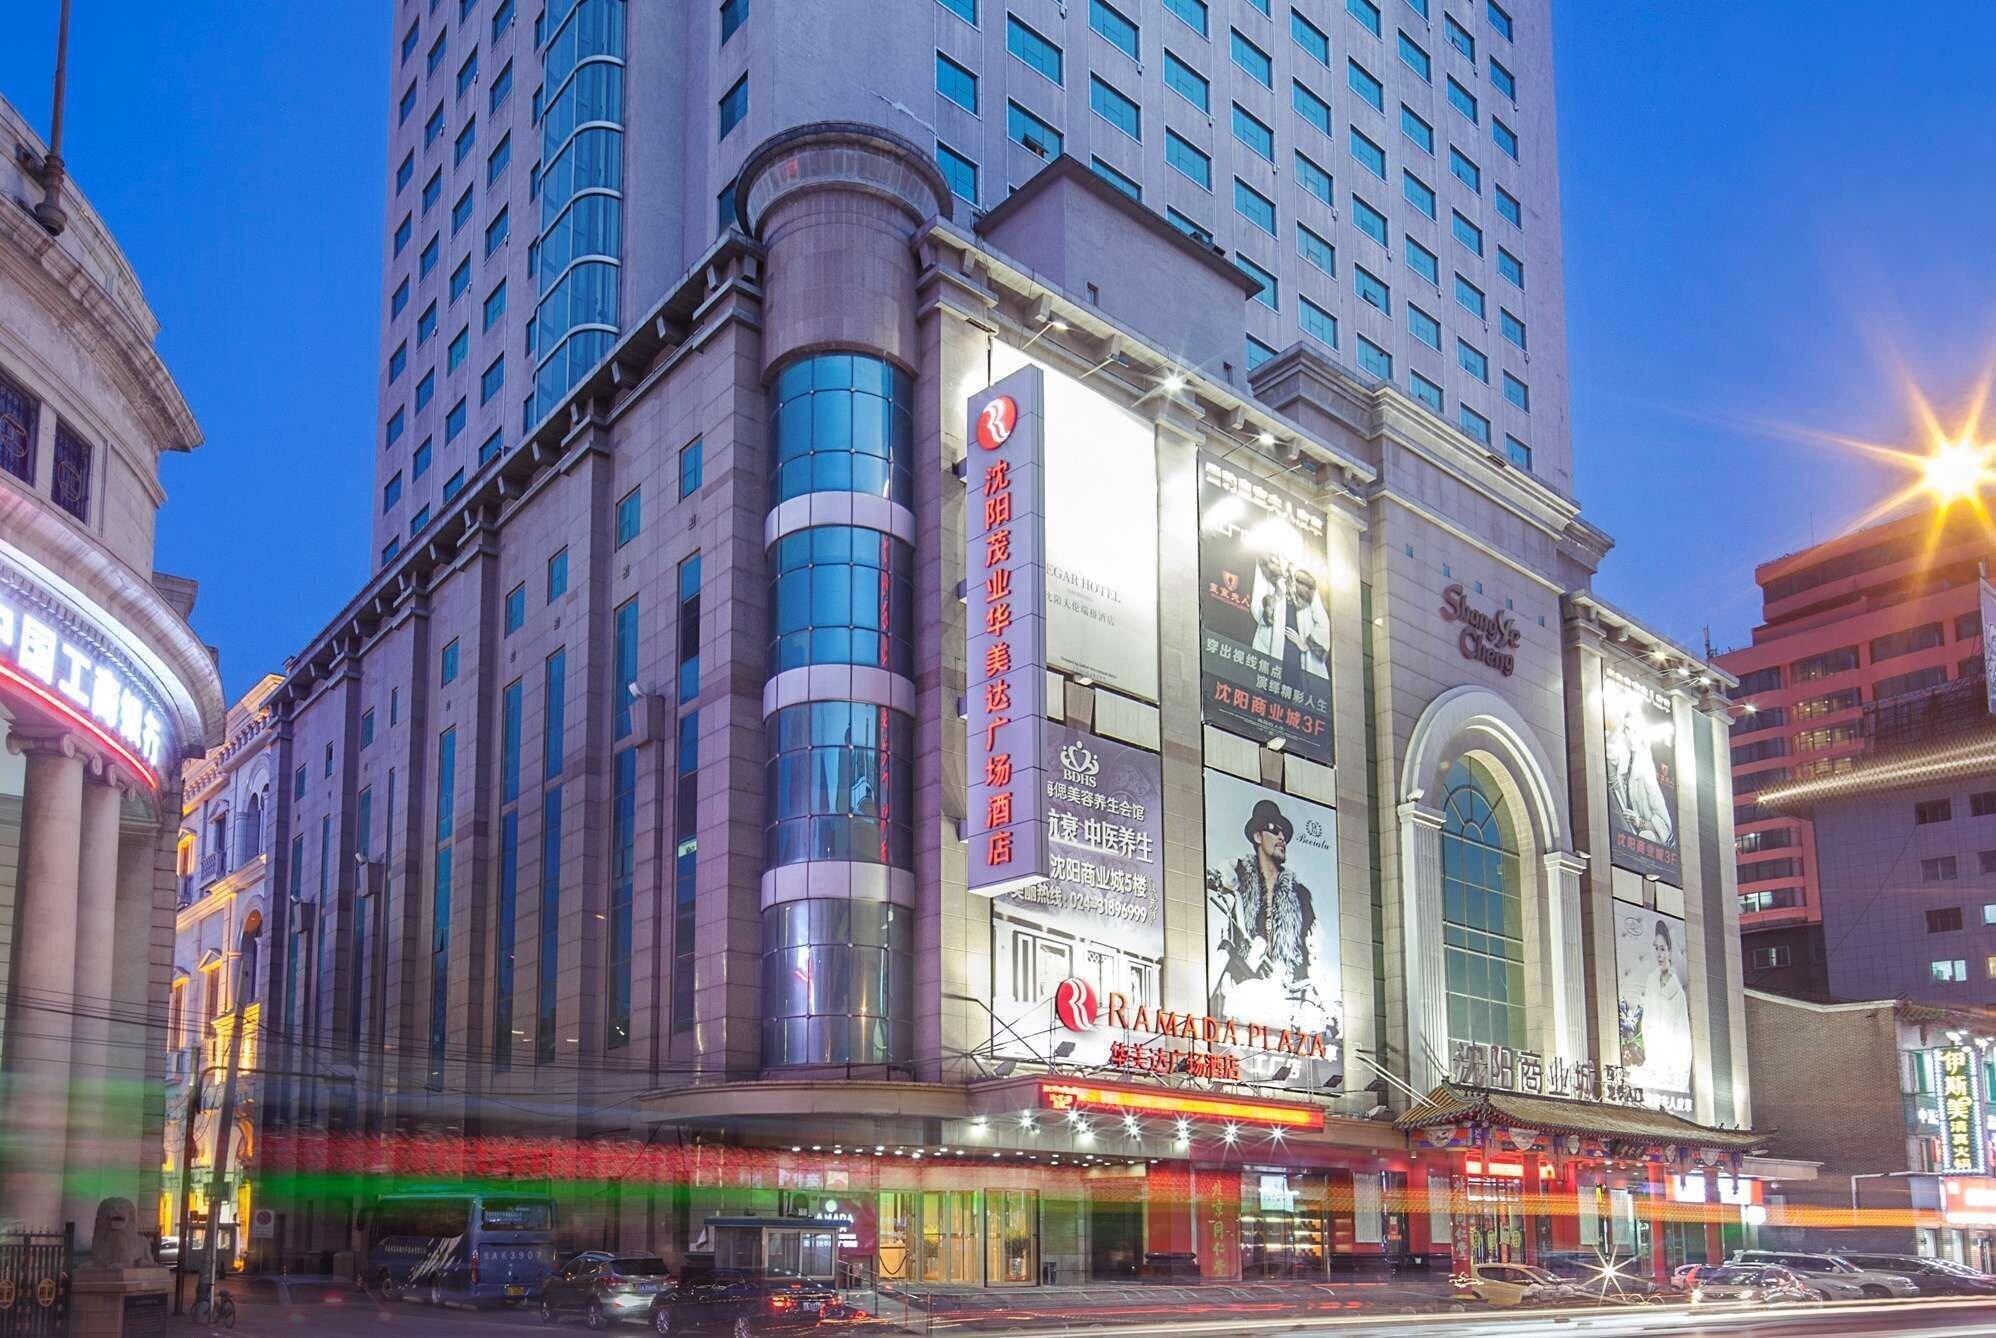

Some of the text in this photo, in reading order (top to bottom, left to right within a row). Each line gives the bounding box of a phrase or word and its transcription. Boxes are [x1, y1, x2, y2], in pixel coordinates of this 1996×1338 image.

[1046, 562, 1079, 588] EGAR
[1082, 576, 1122, 604] HOTEL
[983, 459, 1013, 866] 沈阳茂业华美达广场酒店
[1206, 638, 1283, 680] 穿出视线焦点
[1459, 625, 1515, 677] Cheng
[1215, 681, 1326, 736] 沈阳商业城3F
[1063, 769, 1097, 788] BDHS
[1084, 818, 1154, 864] 中医养生
[1050, 853, 1148, 898] 沈阳商业城5楼
[1108, 991, 1326, 1061] RAMADA PLAZA
[1110, 1041, 1241, 1081] 华美达广场酒店
[1455, 1040, 1597, 1101] 沈阳商业城
